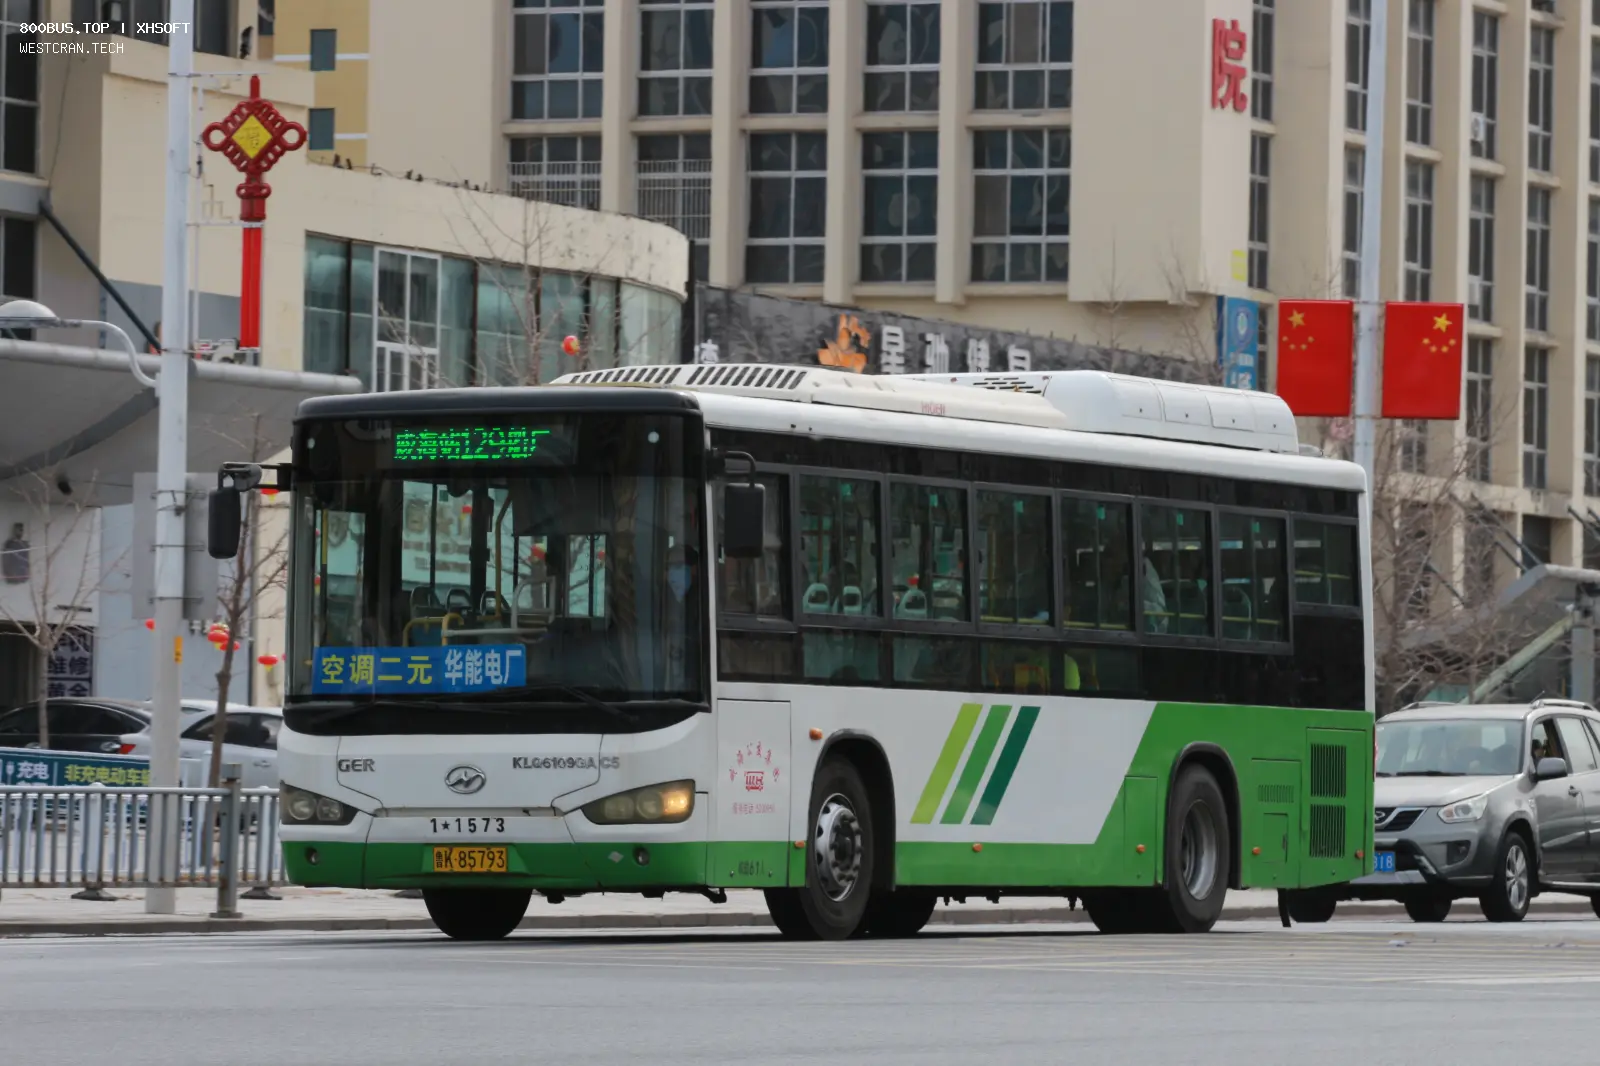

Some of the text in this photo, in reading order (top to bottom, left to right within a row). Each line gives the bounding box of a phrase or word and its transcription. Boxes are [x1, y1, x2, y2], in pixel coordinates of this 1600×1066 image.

[1211, 18, 1247, 114] 院
[321, 648, 522, 686] 空调二元 华能电厂
[16, 760, 49, 780] 充电
[338, 758, 375, 773] GER
